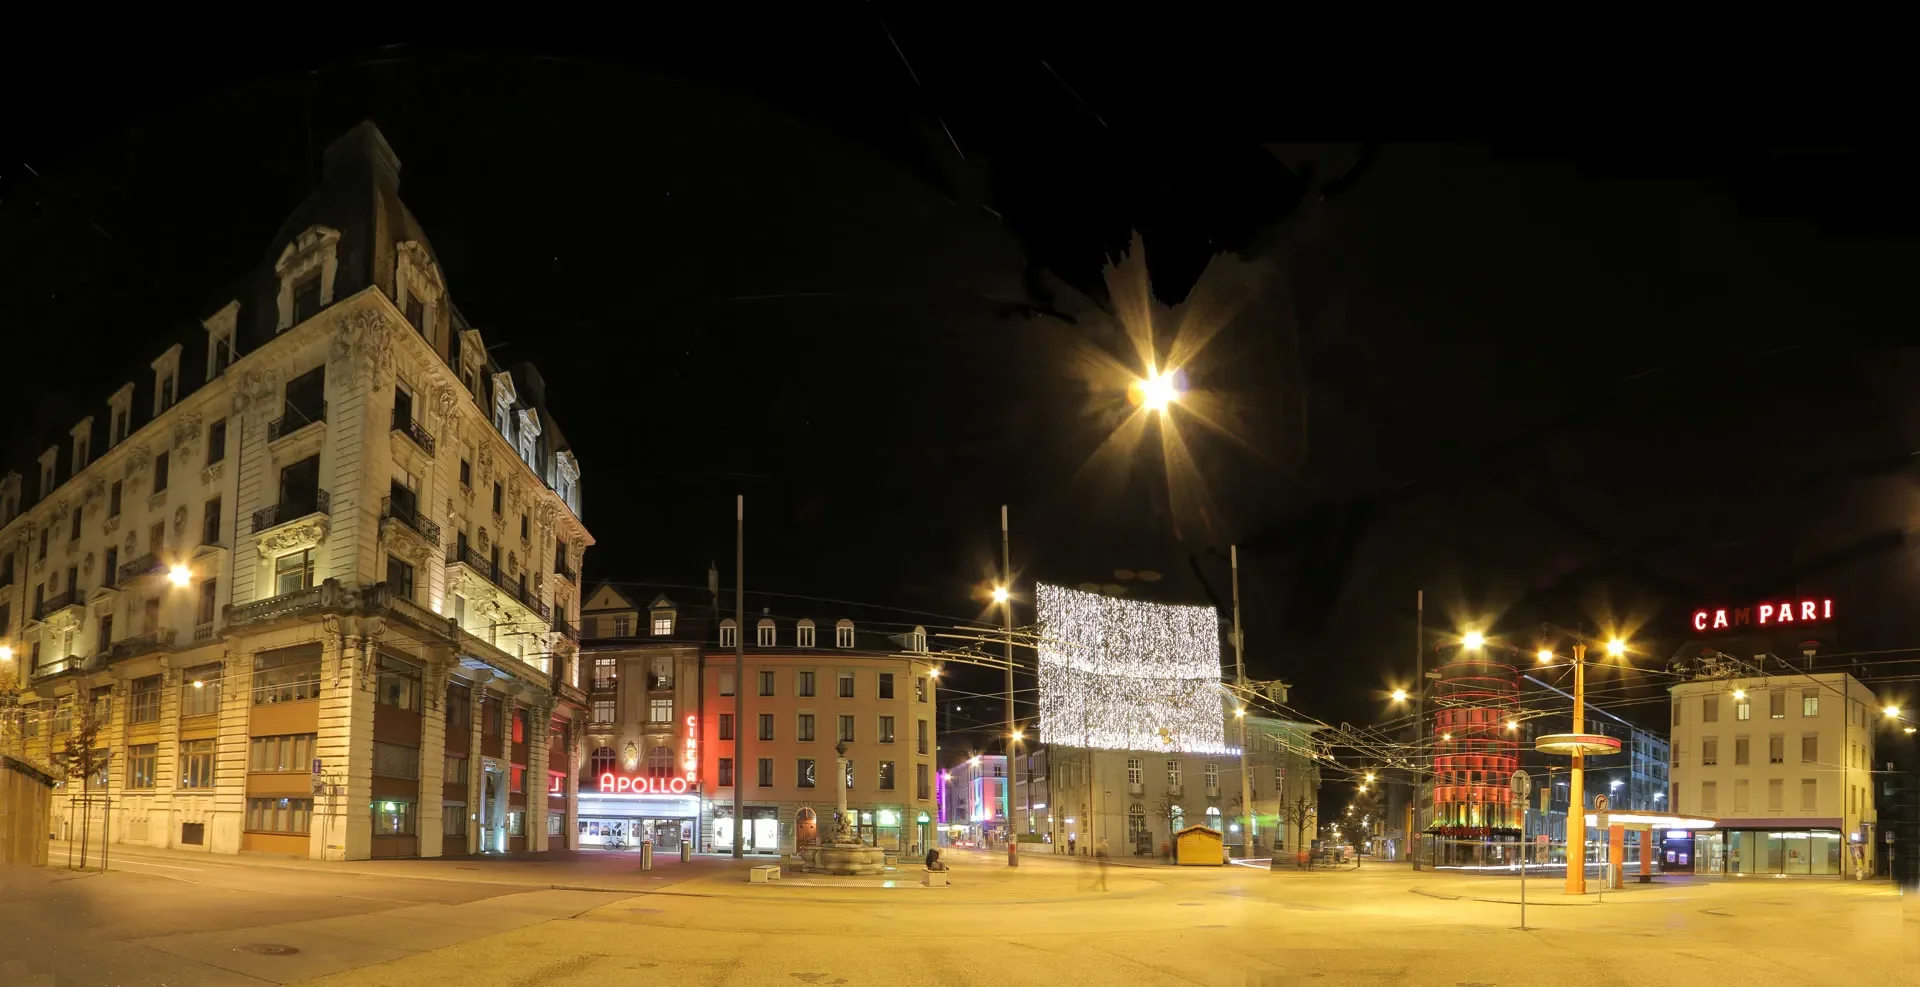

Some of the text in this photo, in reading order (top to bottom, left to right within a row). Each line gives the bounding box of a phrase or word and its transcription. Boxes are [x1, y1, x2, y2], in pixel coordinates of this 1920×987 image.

[1694, 599, 1832, 630] CAMPARI
[686, 715, 697, 782] CINEA
[600, 773, 687, 793] APOLLO
